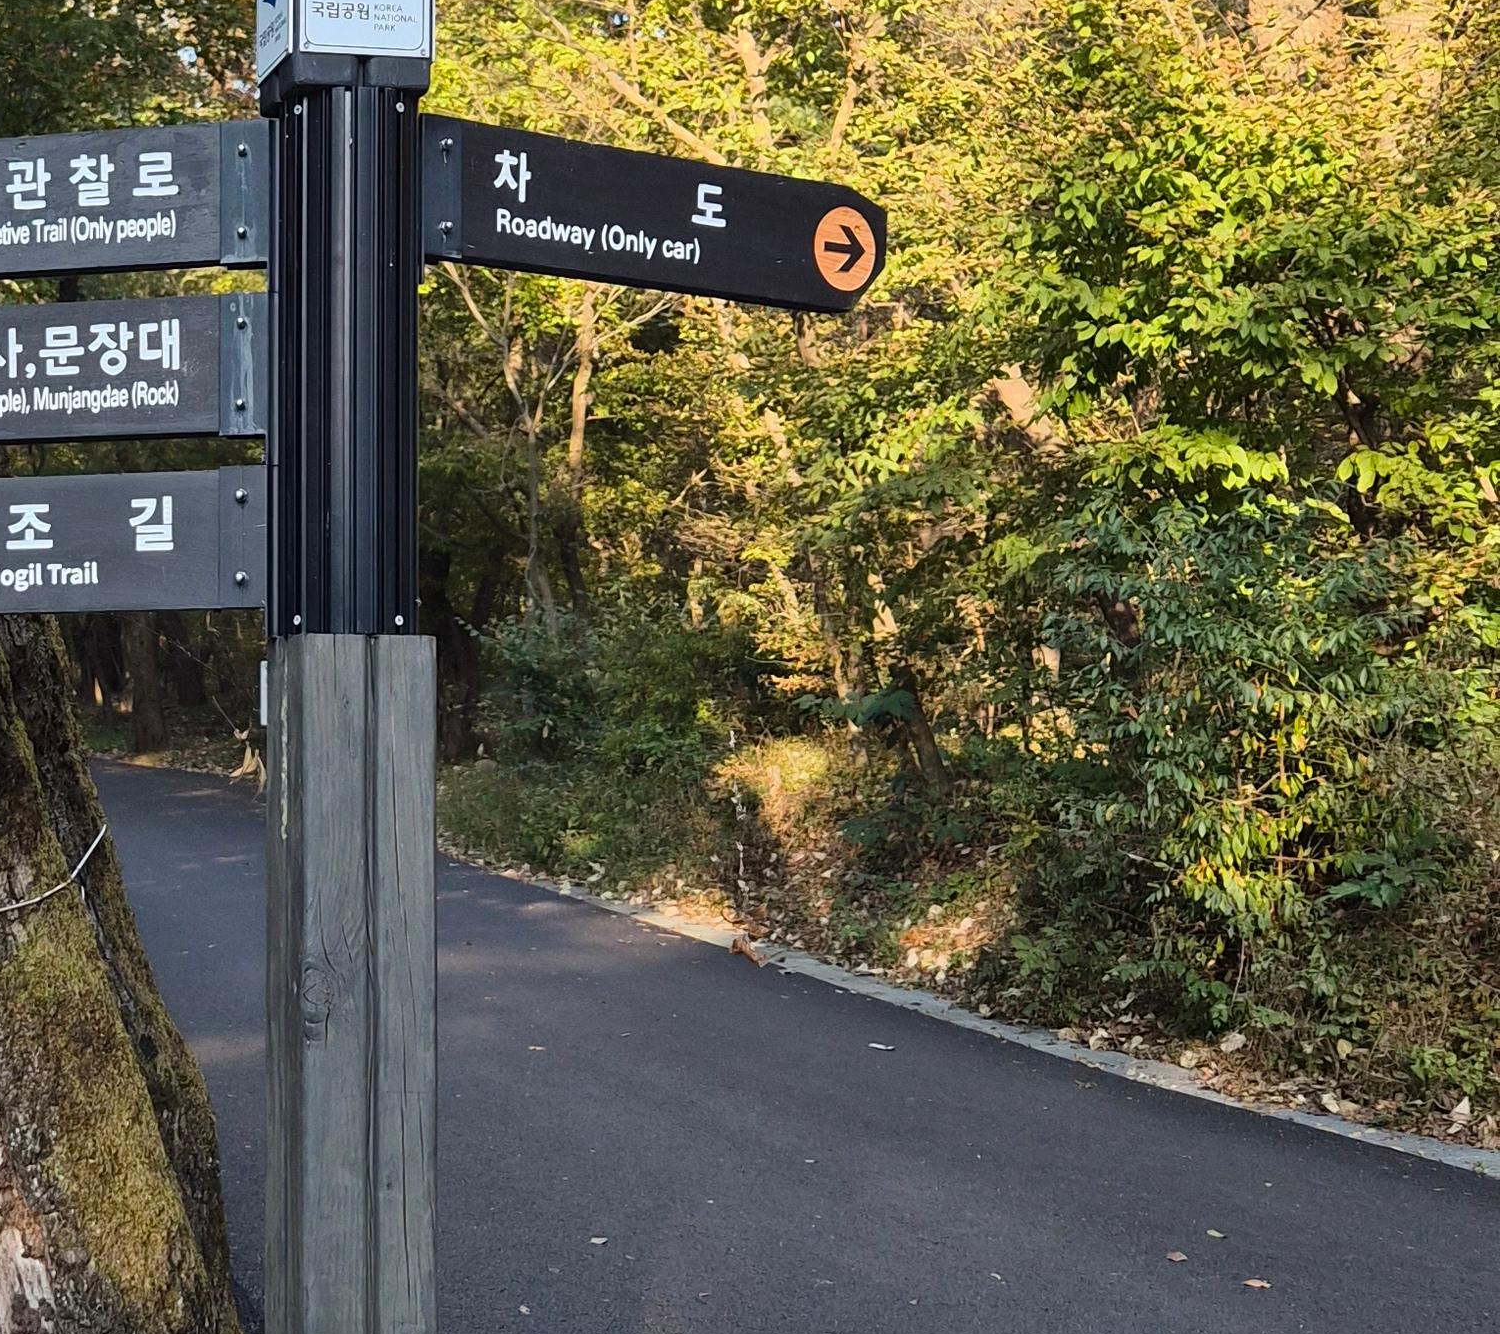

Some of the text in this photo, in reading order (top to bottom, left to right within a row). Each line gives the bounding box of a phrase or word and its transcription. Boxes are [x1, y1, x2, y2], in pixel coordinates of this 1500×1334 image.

[311, 0, 370, 21] 국립공원
[373, 3, 403, 13] KOREA
[373, 13, 418, 24] NATIONAL
[373, 23, 396, 32] PARK
[31, 217, 68, 244] Trail
[69, 215, 115, 245] (Only
[116, 209, 177, 244] people)
[496, 208, 701, 265] Roadway (Only car)
[33, 384, 129, 415] Munjangdae
[131, 379, 180, 410] (Rock)
[46, 561, 99, 586] Trail
